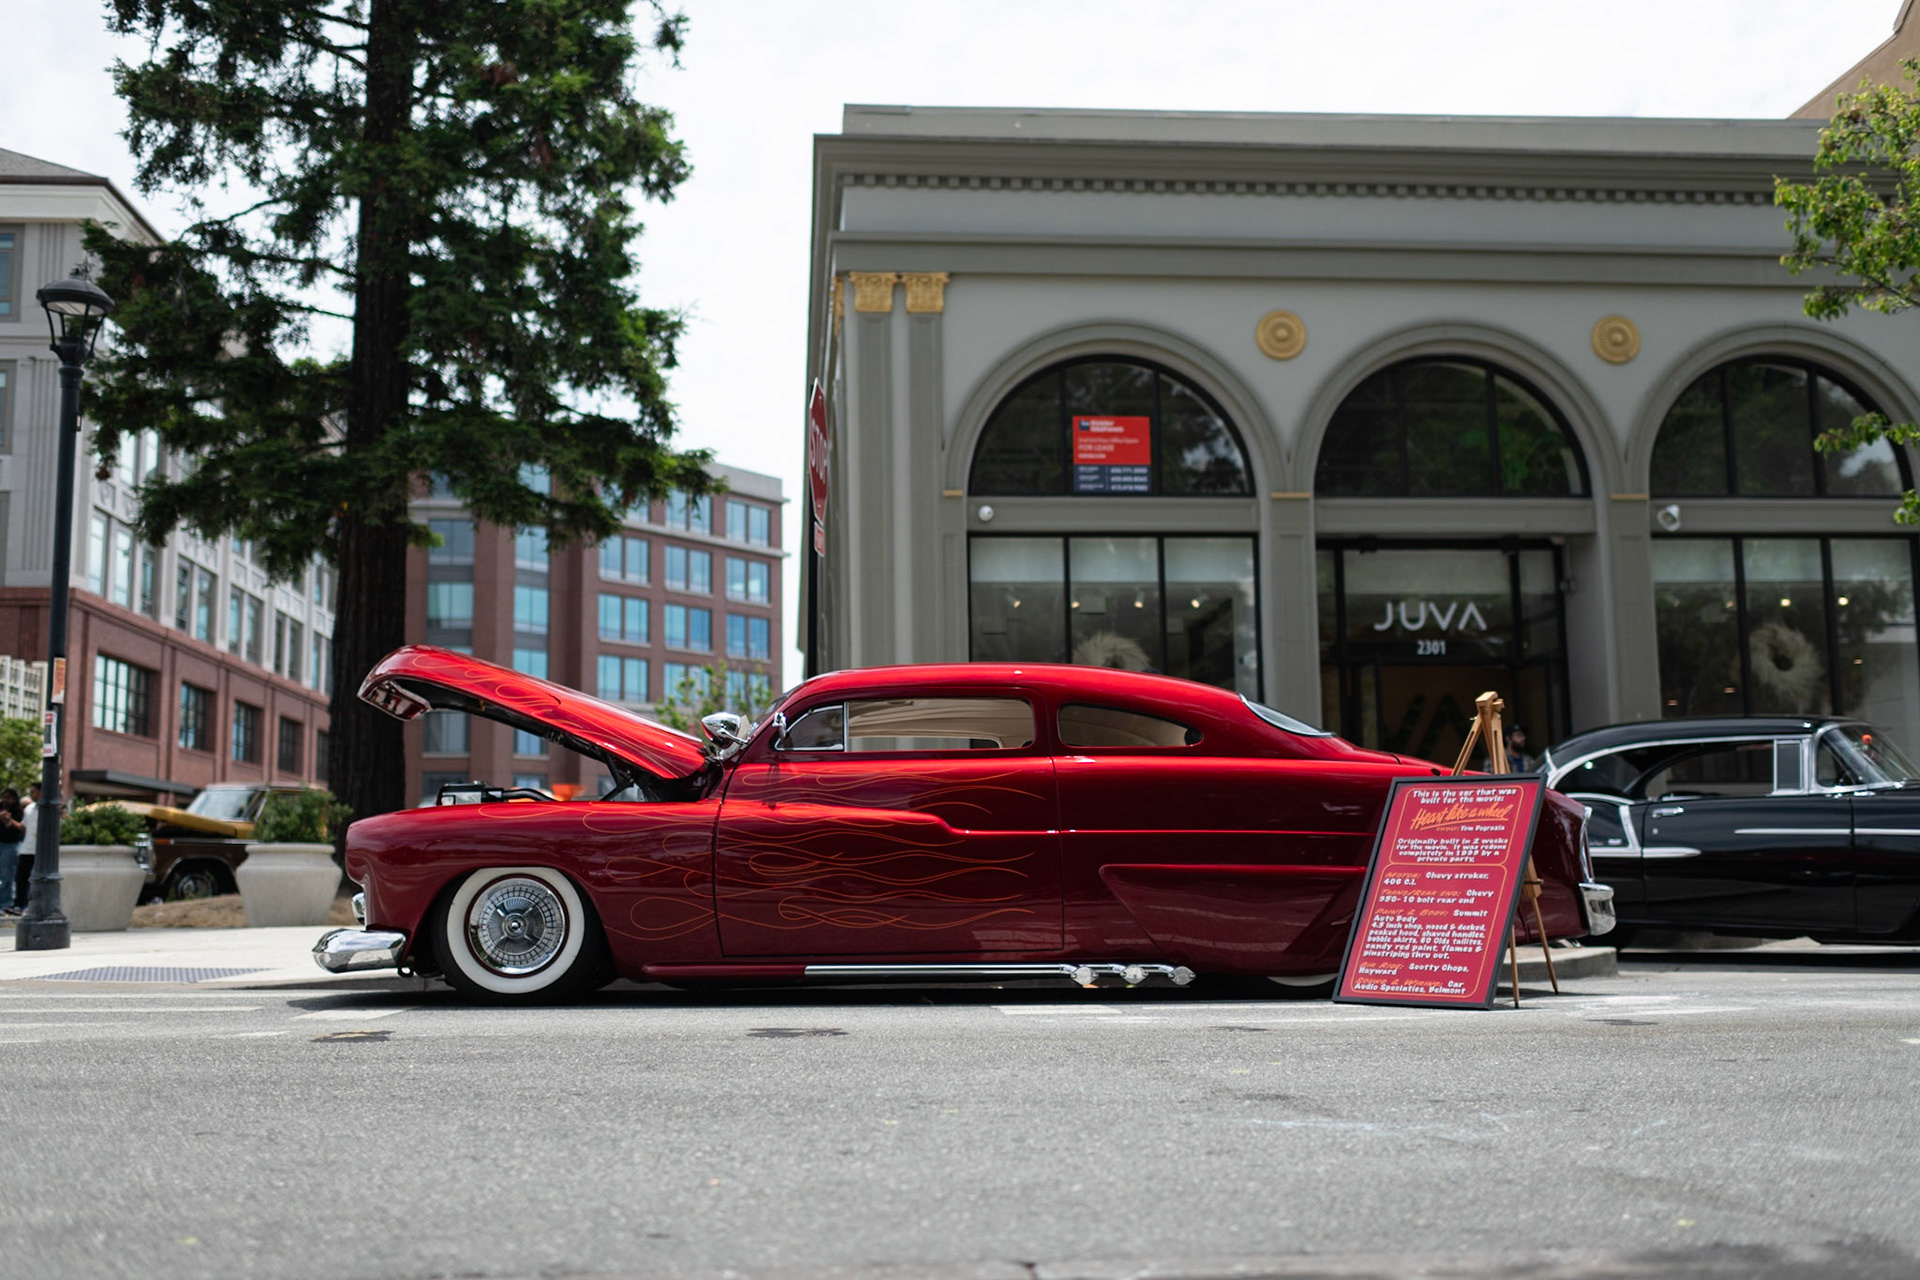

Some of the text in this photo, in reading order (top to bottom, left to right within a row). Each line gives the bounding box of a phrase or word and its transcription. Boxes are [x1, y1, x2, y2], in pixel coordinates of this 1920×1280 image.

[1374, 602, 1488, 631] JUVA
[1417, 641, 1446, 655] 2301
[1442, 789, 1457, 797] the
[1477, 788, 1496, 796] that
[1410, 808, 1449, 830] Heart
[1445, 803, 1469, 821] like
[1476, 802, 1514, 818] wheel
[1426, 872, 1452, 880] Chevy
[1466, 890, 1494, 898] Chevy
[1396, 915, 1417, 923] Body
[1369, 929, 1398, 937] peaked
[1422, 930, 1450, 938] shaved
[1433, 937, 1450, 945] Olds
[1366, 943, 1392, 951] candy
[1442, 945, 1474, 953] flames
[1363, 950, 1410, 959] pinstriping
[1359, 968, 1397, 976] Hayward
[1409, 963, 1440, 972] Scotty
[1448, 980, 1465, 988] Car
[1354, 983, 1378, 991] Audio
[1429, 986, 1466, 995] Belmont
